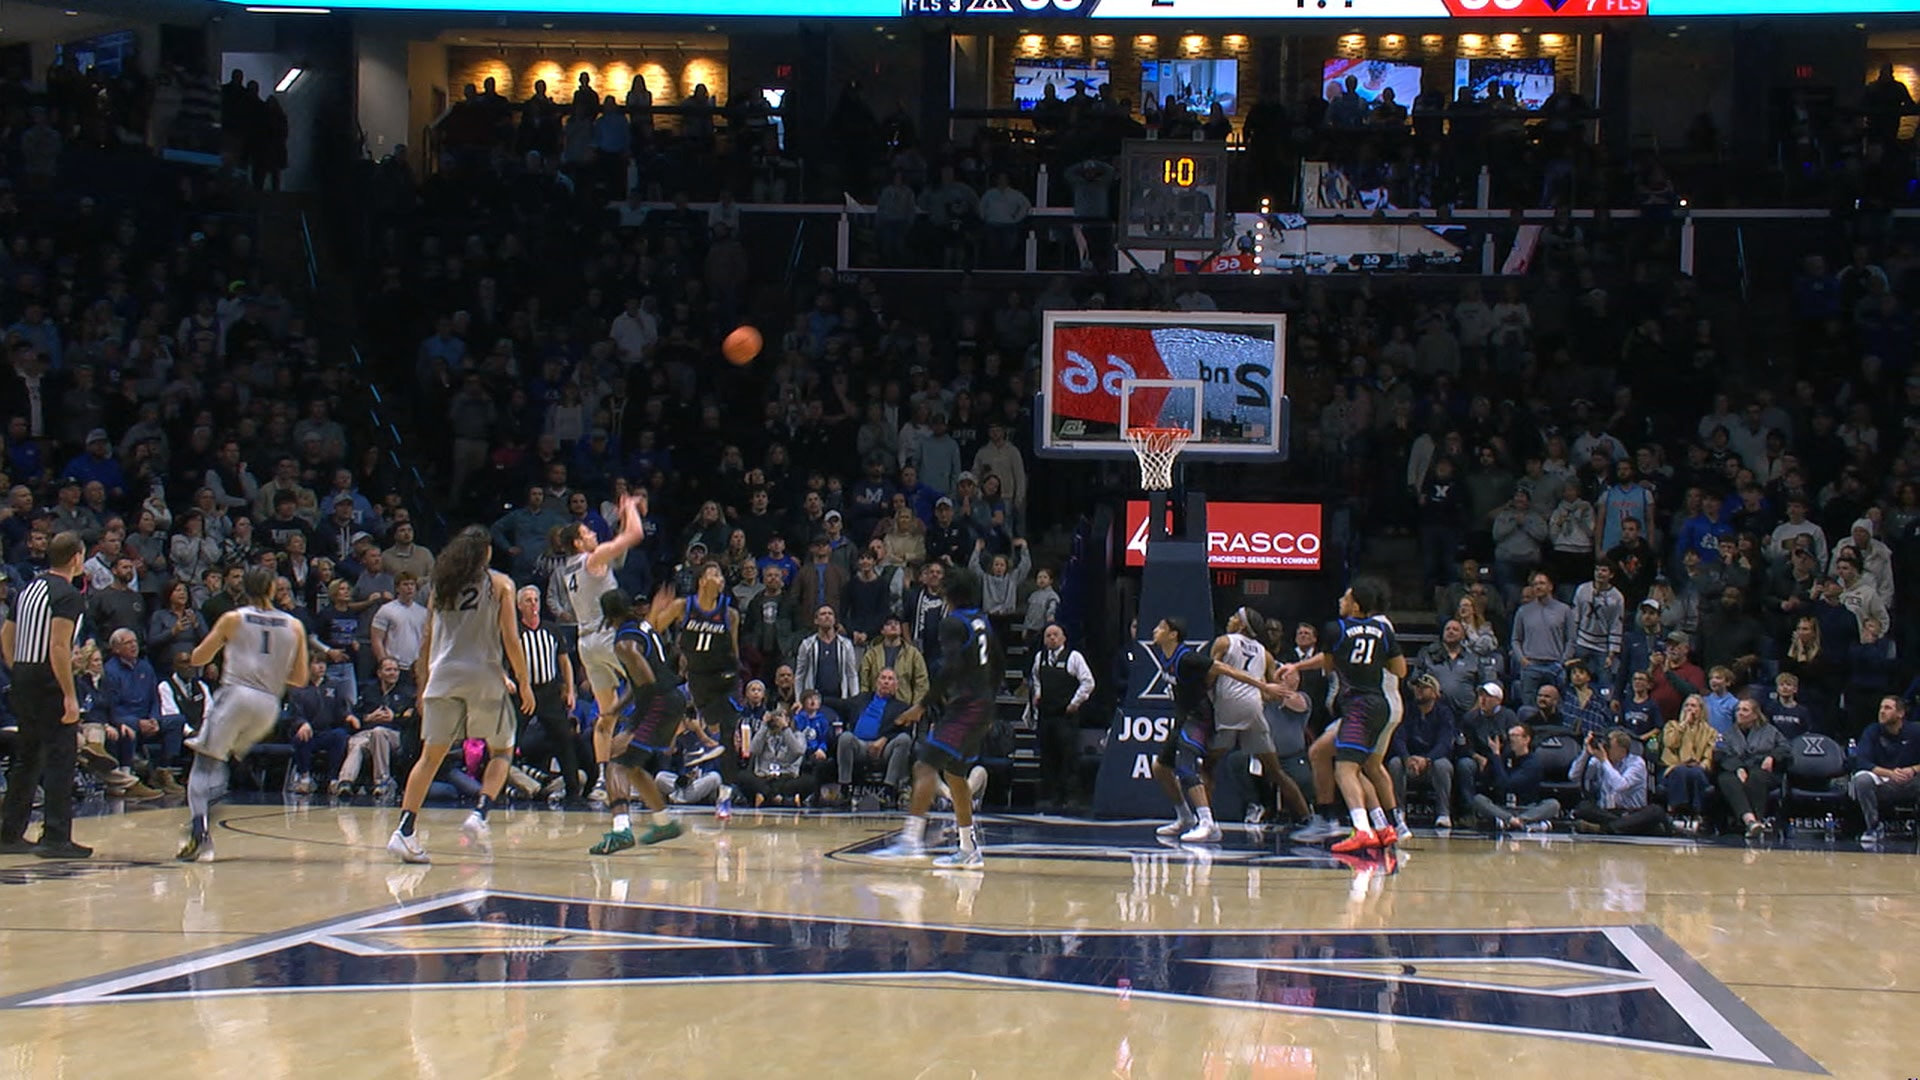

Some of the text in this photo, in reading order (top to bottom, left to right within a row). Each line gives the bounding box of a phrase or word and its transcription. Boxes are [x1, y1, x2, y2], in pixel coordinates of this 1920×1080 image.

[909, 0, 941, 11] FLS
[1207, 531, 1320, 554] RASCO
[568, 573, 578, 592] 4
[460, 587, 478, 611] 2
[695, 633, 712, 652] 11
[1350, 638, 1375, 664] 21
